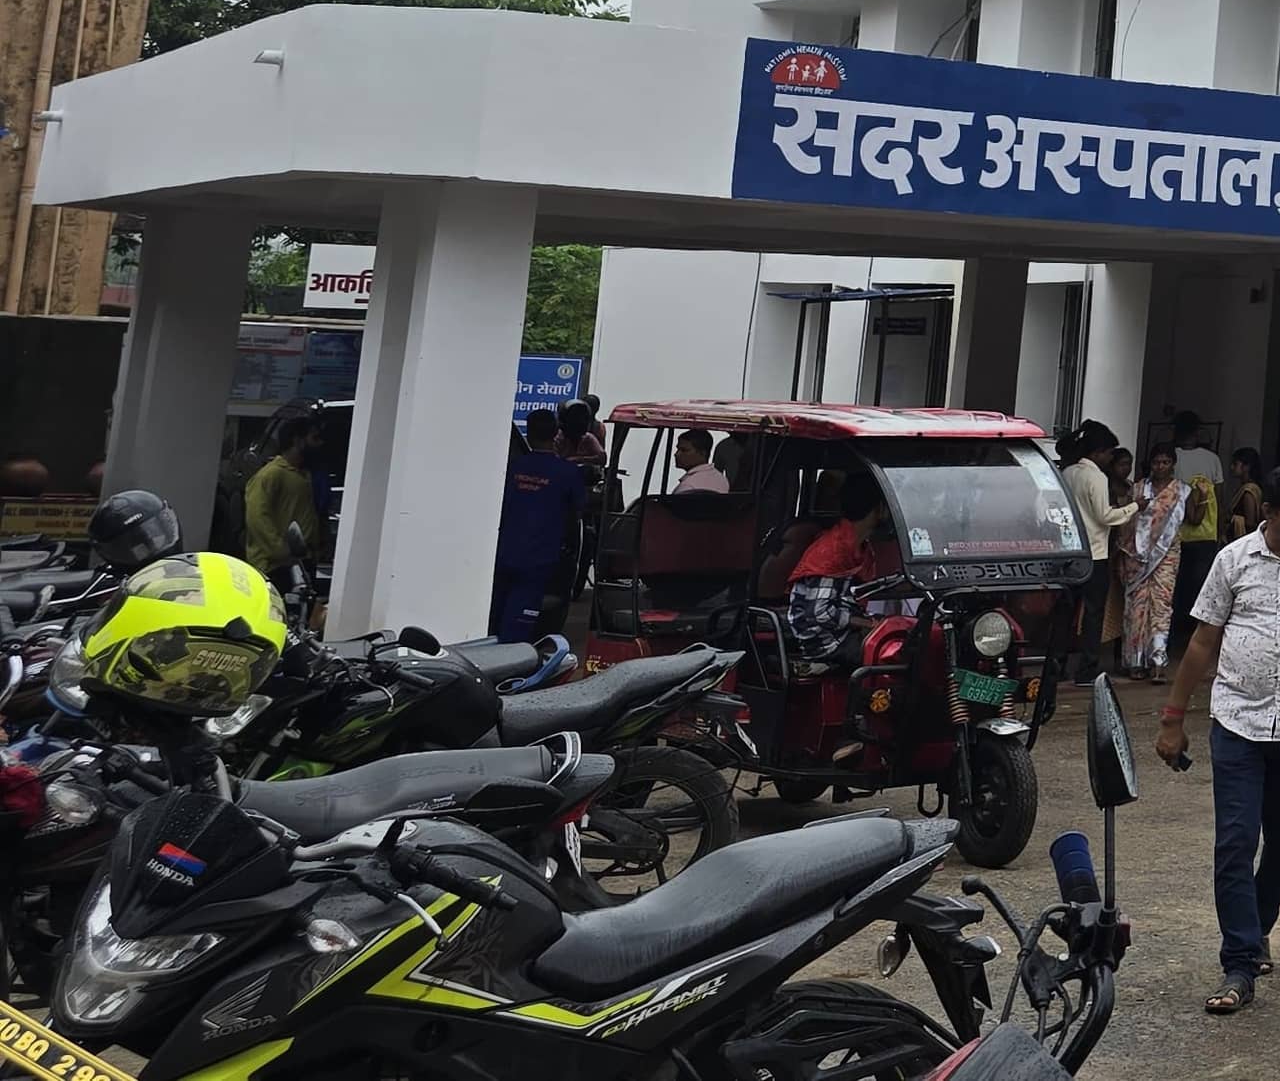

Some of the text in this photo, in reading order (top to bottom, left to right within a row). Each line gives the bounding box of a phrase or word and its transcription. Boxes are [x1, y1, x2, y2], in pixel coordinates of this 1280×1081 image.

[771, 92, 974, 196] सदर
[972, 562, 1038, 579] DELTIC
[192, 649, 248, 672] STUDDS
[146, 857, 195, 887] HONDA
[201, 1014, 277, 1041] HONDA
